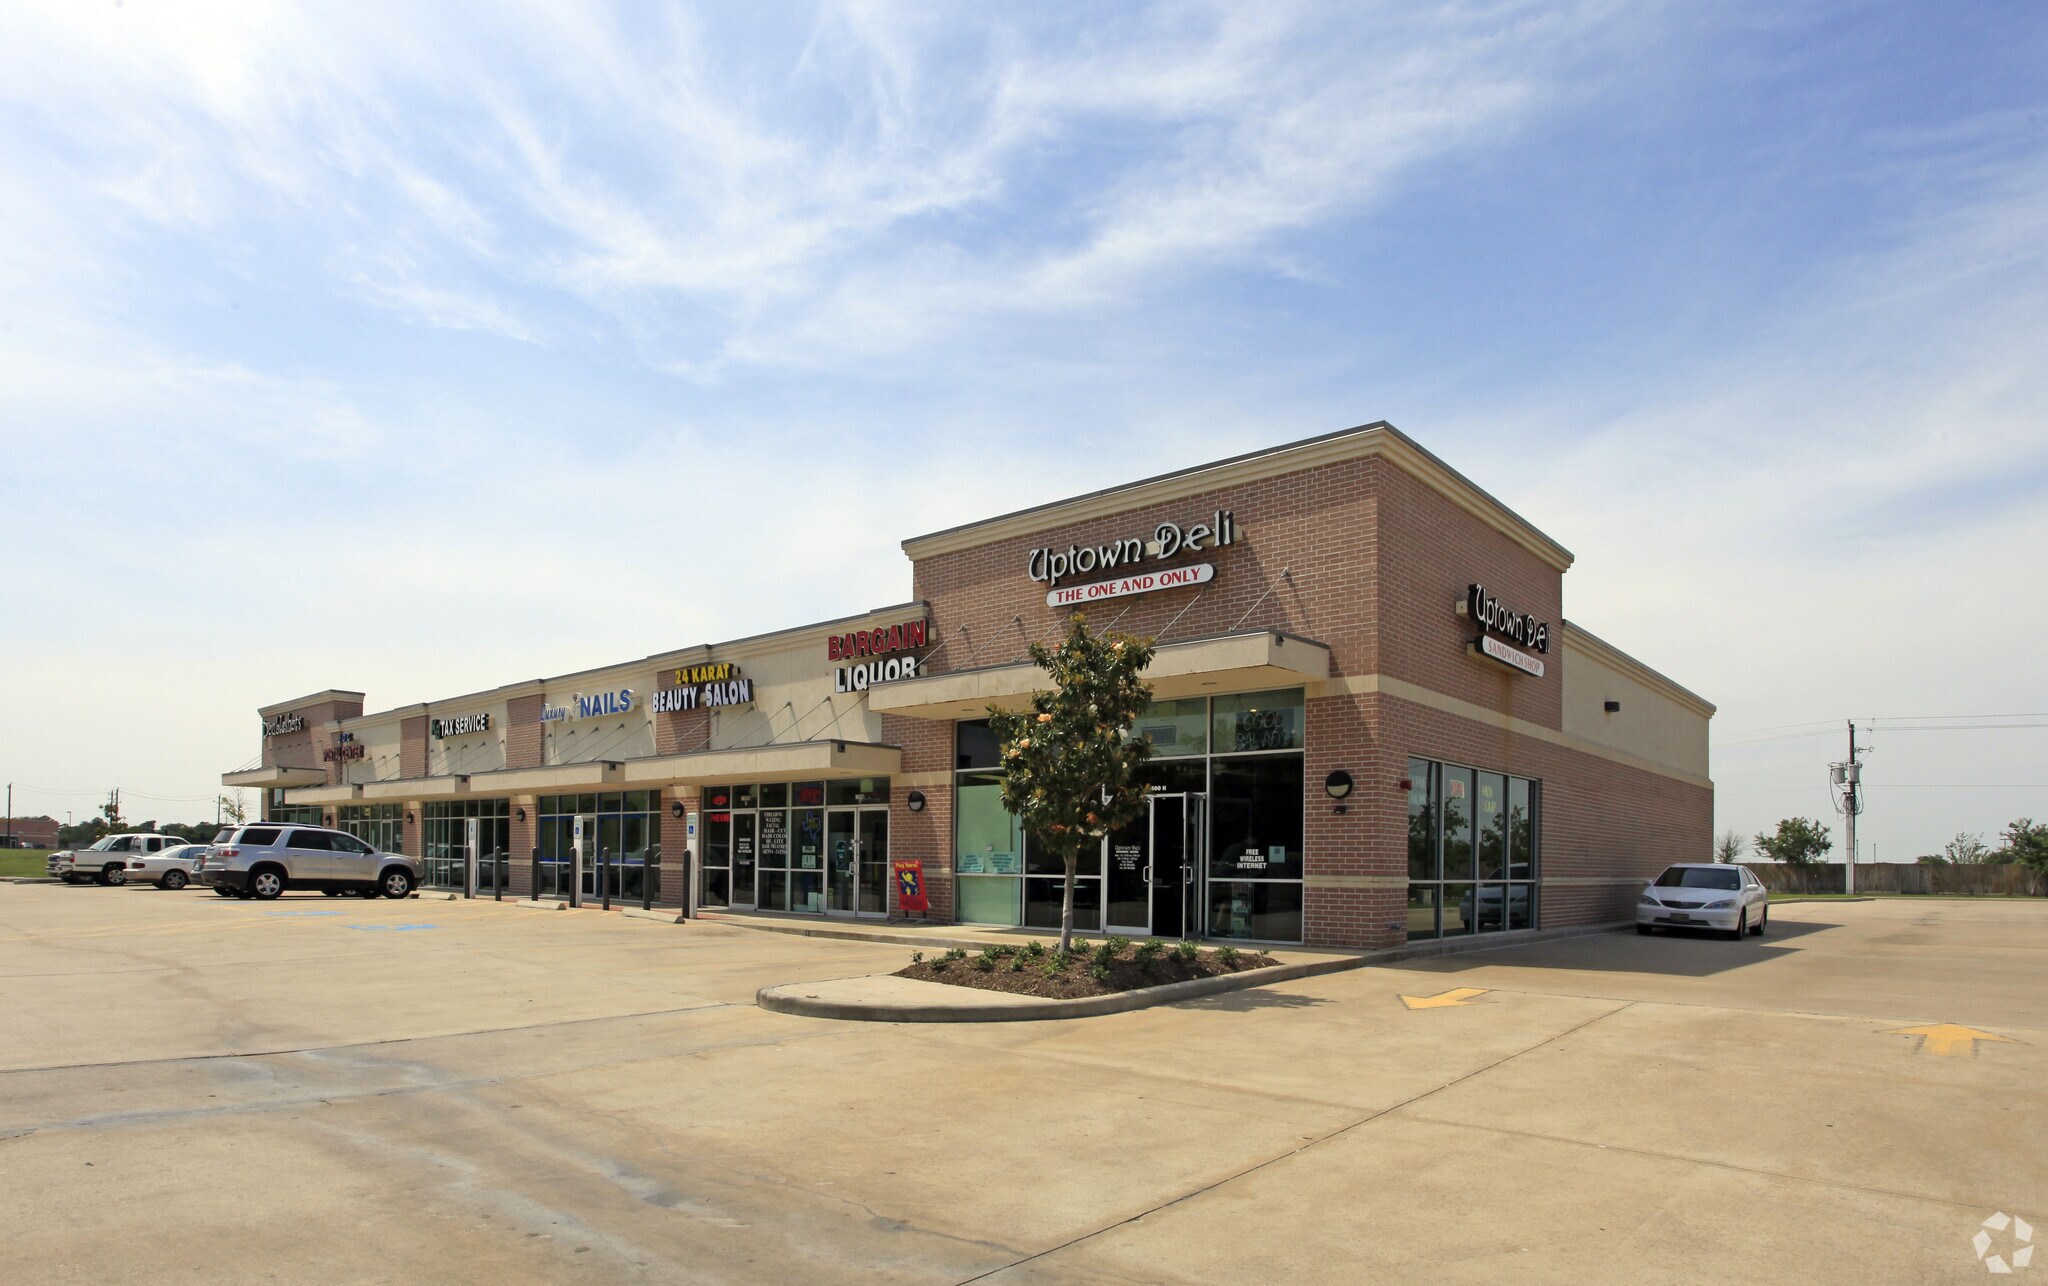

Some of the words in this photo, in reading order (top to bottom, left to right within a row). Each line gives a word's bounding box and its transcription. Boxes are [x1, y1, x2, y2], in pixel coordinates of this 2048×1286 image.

[1028, 538, 1143, 587] Uptown
[1154, 509, 1233, 560] Deli
[1056, 588, 1083, 603] THE
[1087, 583, 1117, 598] ONE
[1120, 576, 1154, 593] AND
[1159, 567, 1201, 586] ONLY
[1474, 583, 1523, 641] Uptown
[828, 617, 926, 662] BARGAIN
[1488, 640, 1524, 668] SANDWICH
[1524, 658, 1540, 673] SHOP
[675, 668, 689, 685] 24
[691, 663, 730, 683] KARAT
[835, 656, 916, 693] LIQUOR
[580, 688, 632, 718] NAILS
[652, 686, 698, 713] BEAUTY
[705, 679, 750, 707] SALON
[440, 719, 454, 737] TAX
[455, 713, 486, 735] SERVICE
